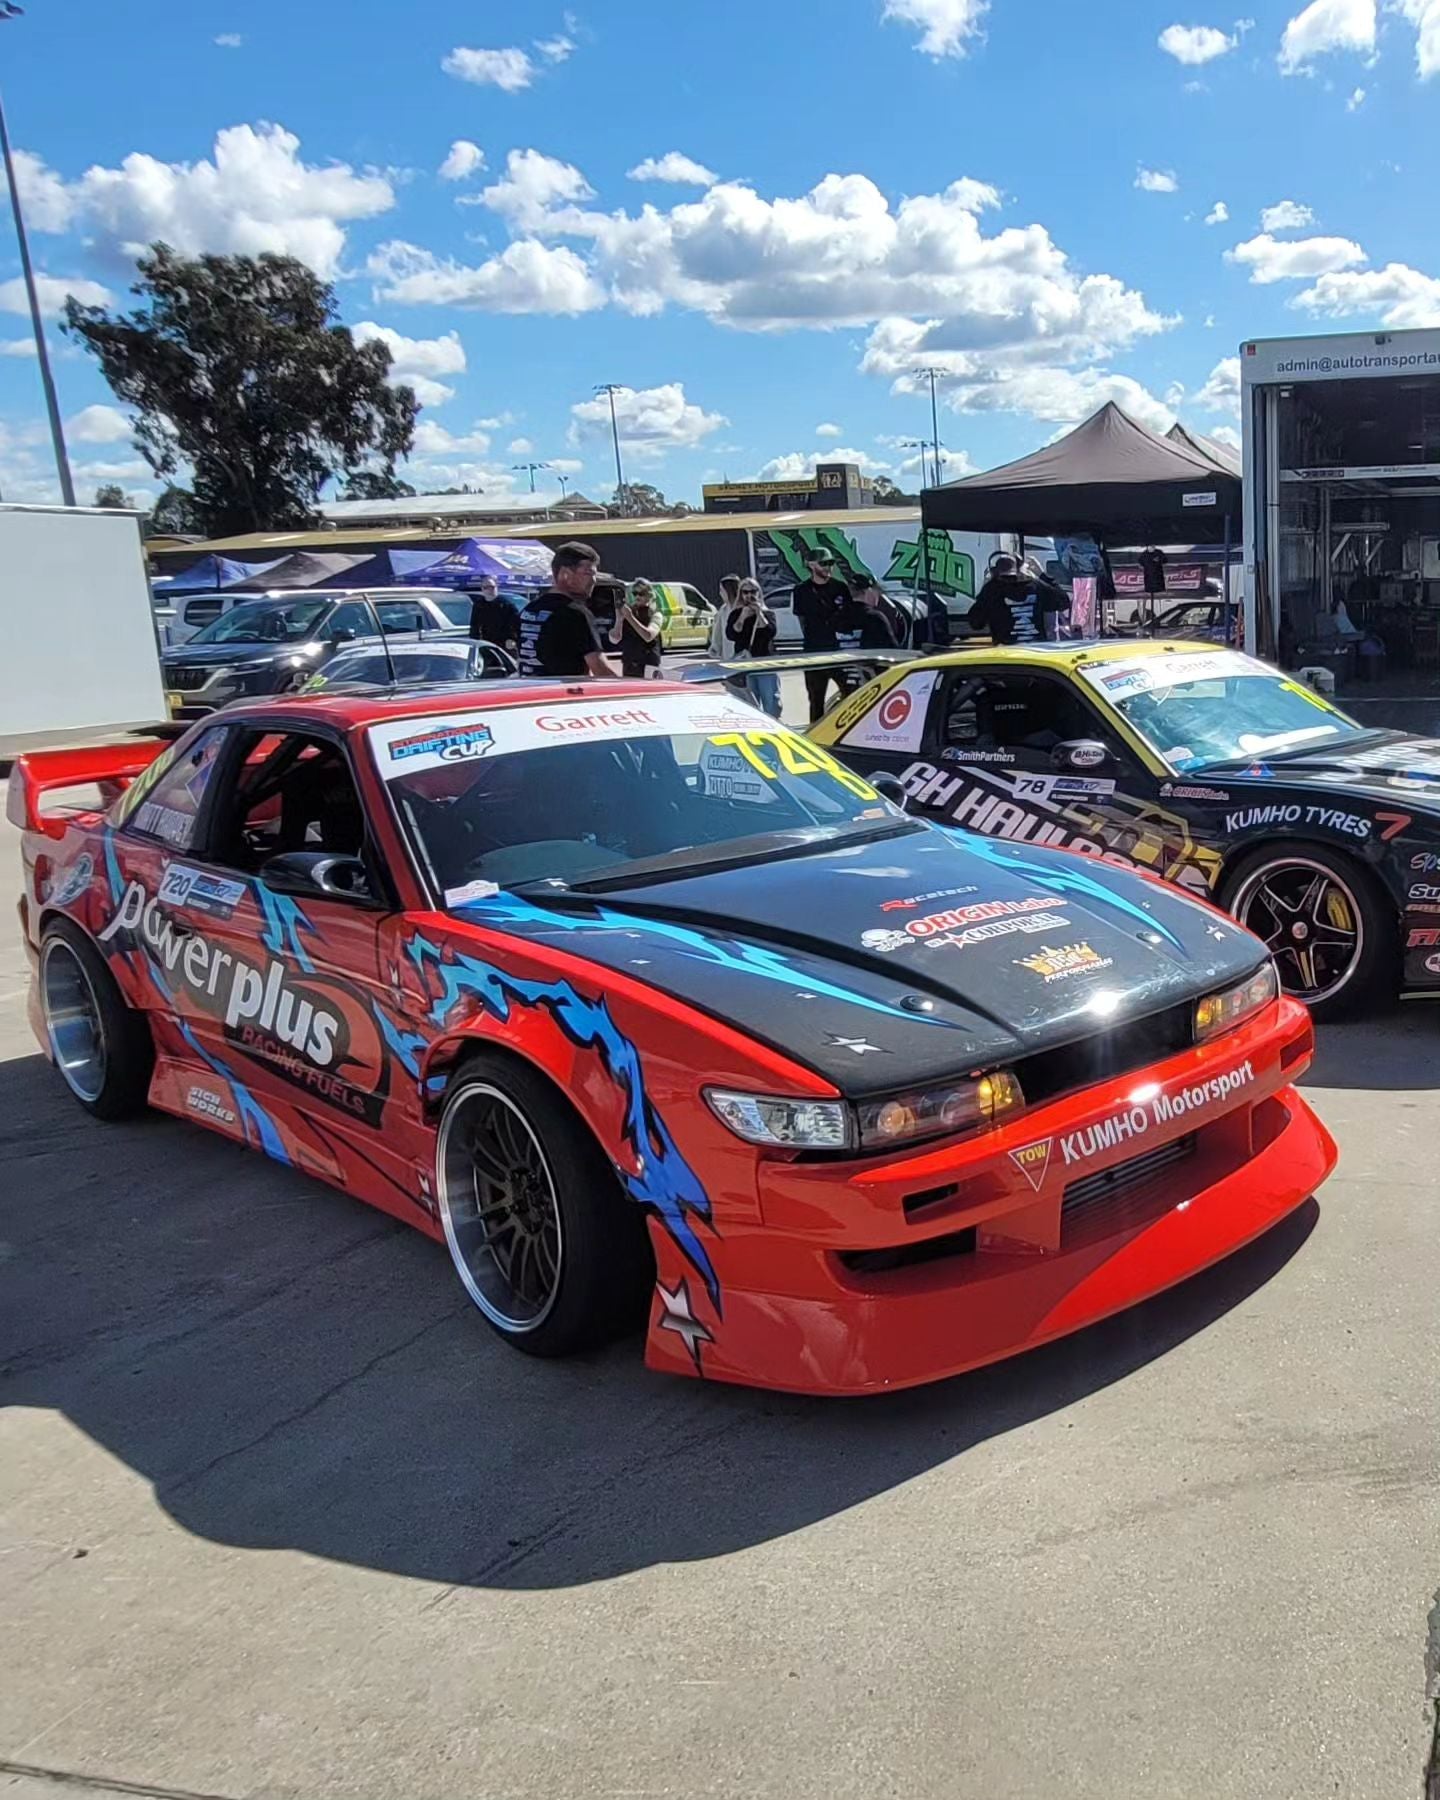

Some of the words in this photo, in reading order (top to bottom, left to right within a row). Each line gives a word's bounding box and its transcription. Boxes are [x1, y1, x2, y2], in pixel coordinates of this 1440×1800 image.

[535, 710, 656, 732] Garrett
[393, 731, 490, 760] DRIFTING
[441, 741, 494, 761] CUP
[958, 750, 1016, 762] SmithPartners
[706, 732, 878, 801] 720
[1018, 779, 1046, 795] 78
[1225, 804, 1302, 833] KUMHO
[1305, 806, 1372, 838] TYRES
[163, 872, 192, 897] 720
[907, 901, 1008, 934] ORIGIN
[242, 1024, 309, 1082] RACING
[305, 1072, 365, 1115] FUELS
[1060, 1106, 1148, 1165] KUMHO
[1152, 1060, 1255, 1125] Motorsport
[1016, 1143, 1048, 1165] TOW
